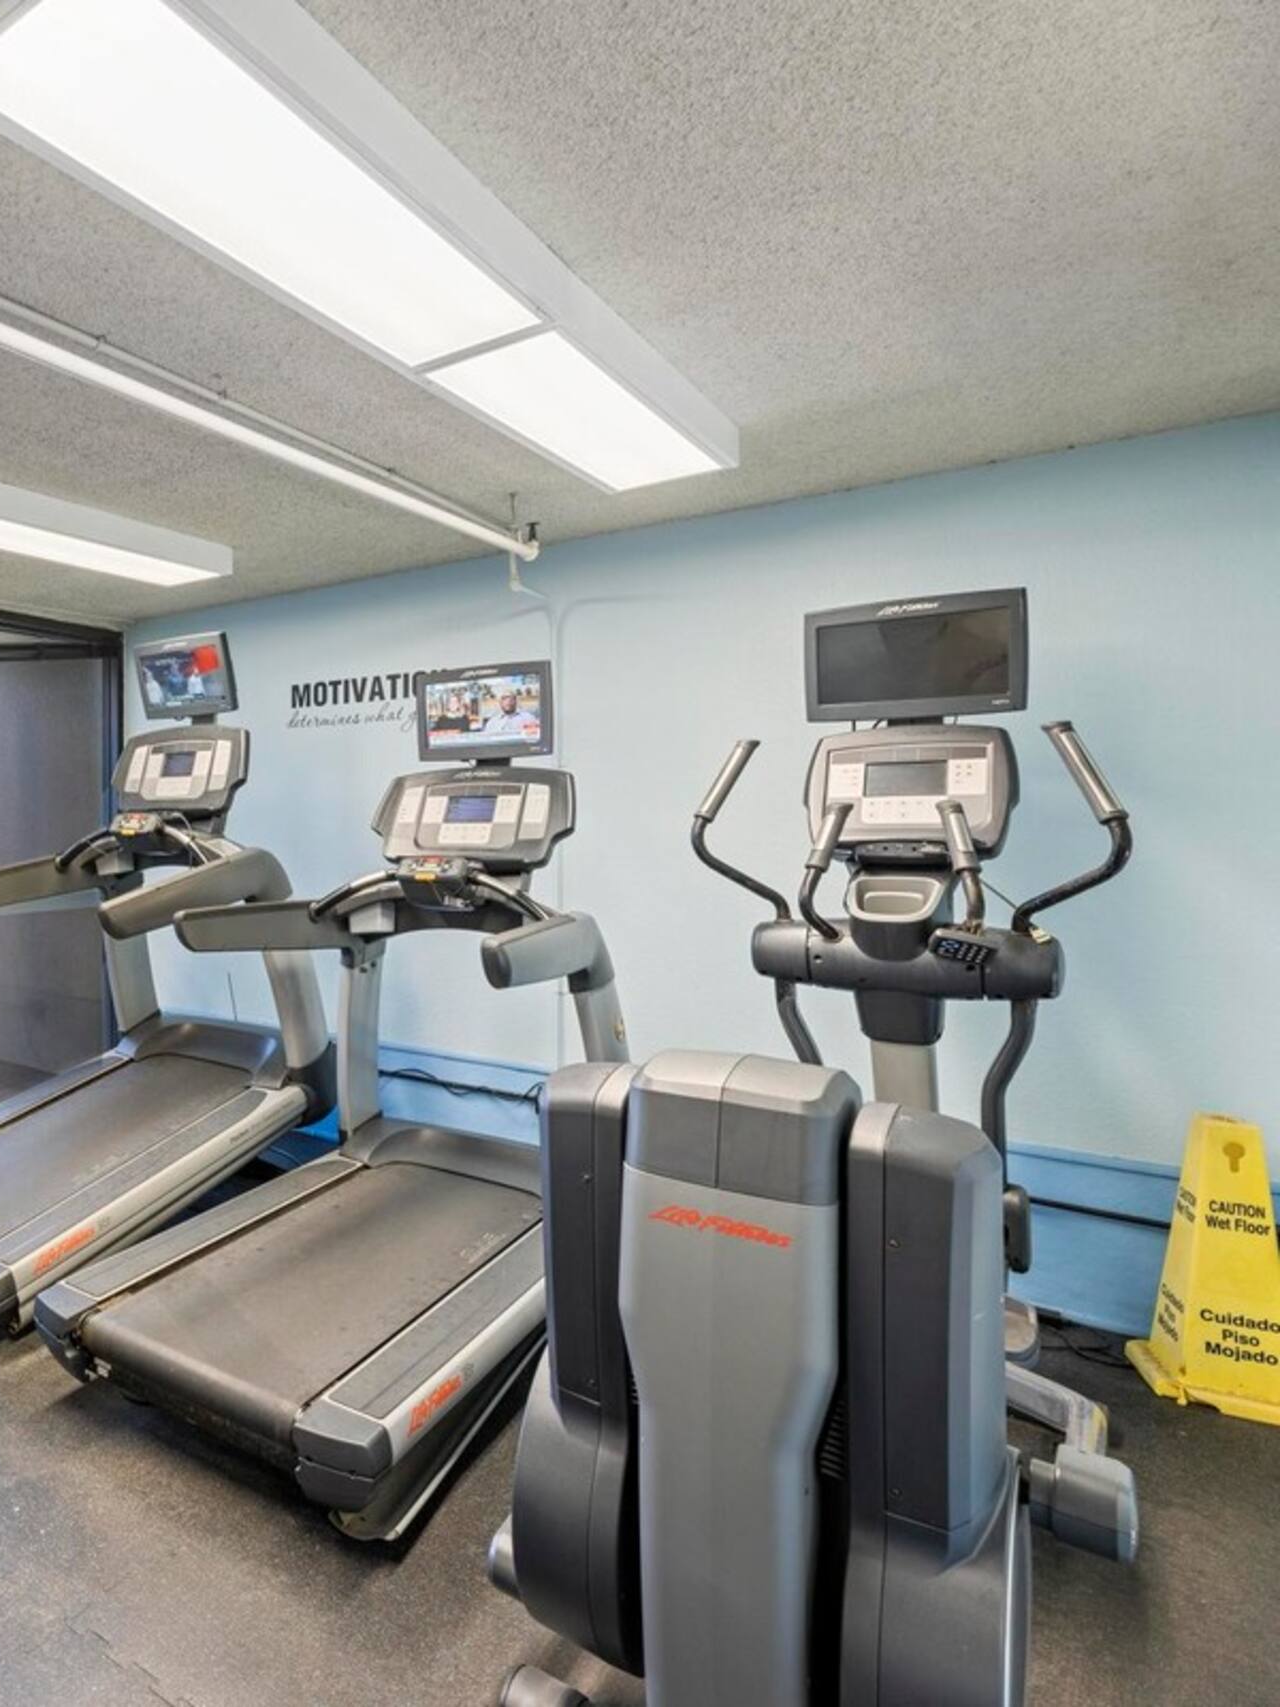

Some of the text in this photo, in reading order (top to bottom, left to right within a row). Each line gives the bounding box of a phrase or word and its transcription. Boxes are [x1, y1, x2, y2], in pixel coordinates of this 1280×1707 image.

[291, 671, 448, 709] MOTIVATIO
[1208, 1199, 1266, 1219] CAUTION
[1204, 1214, 1271, 1236] Wet Floor
[1200, 1308, 1280, 1333] Cuidado
[1222, 1328, 1260, 1347] Piso
[1205, 1341, 1279, 1366] Mojado
